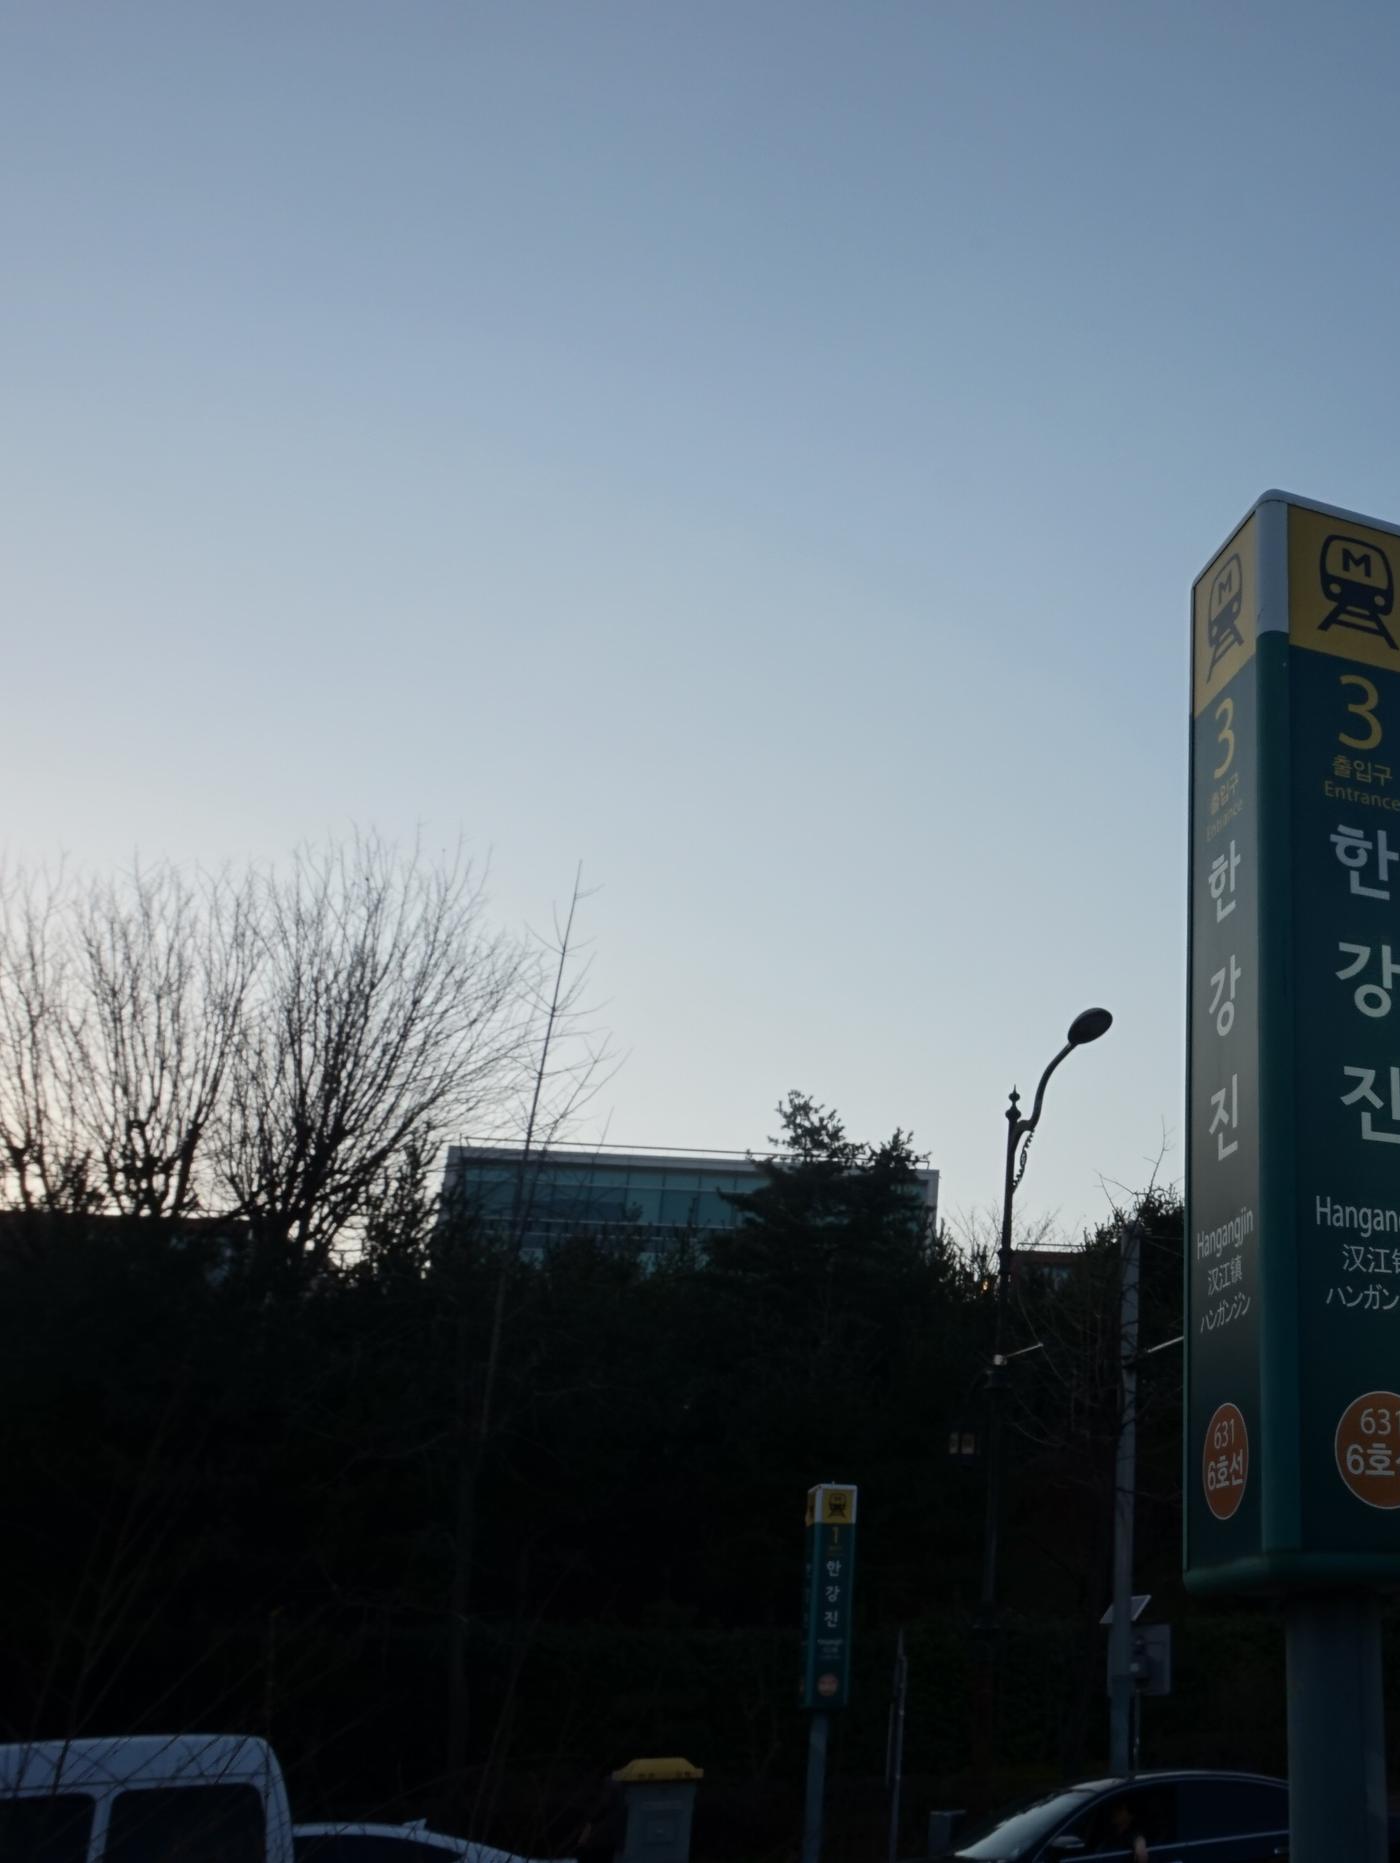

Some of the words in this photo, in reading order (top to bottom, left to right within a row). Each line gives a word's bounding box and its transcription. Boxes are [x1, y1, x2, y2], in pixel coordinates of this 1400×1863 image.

[1342, 548, 1371, 578] M
[1338, 674, 1384, 750] 3
[1213, 697, 1236, 779] 3
[1332, 754, 1393, 787] 출입구
[1208, 839, 1242, 1162] 한강진
[1197, 1206, 1254, 1260] Hangangjin
[1200, 1292, 1251, 1334] ハンガンジン
[1214, 1418, 1236, 1449] 631
[1207, 1448, 1244, 1491] 6호선
